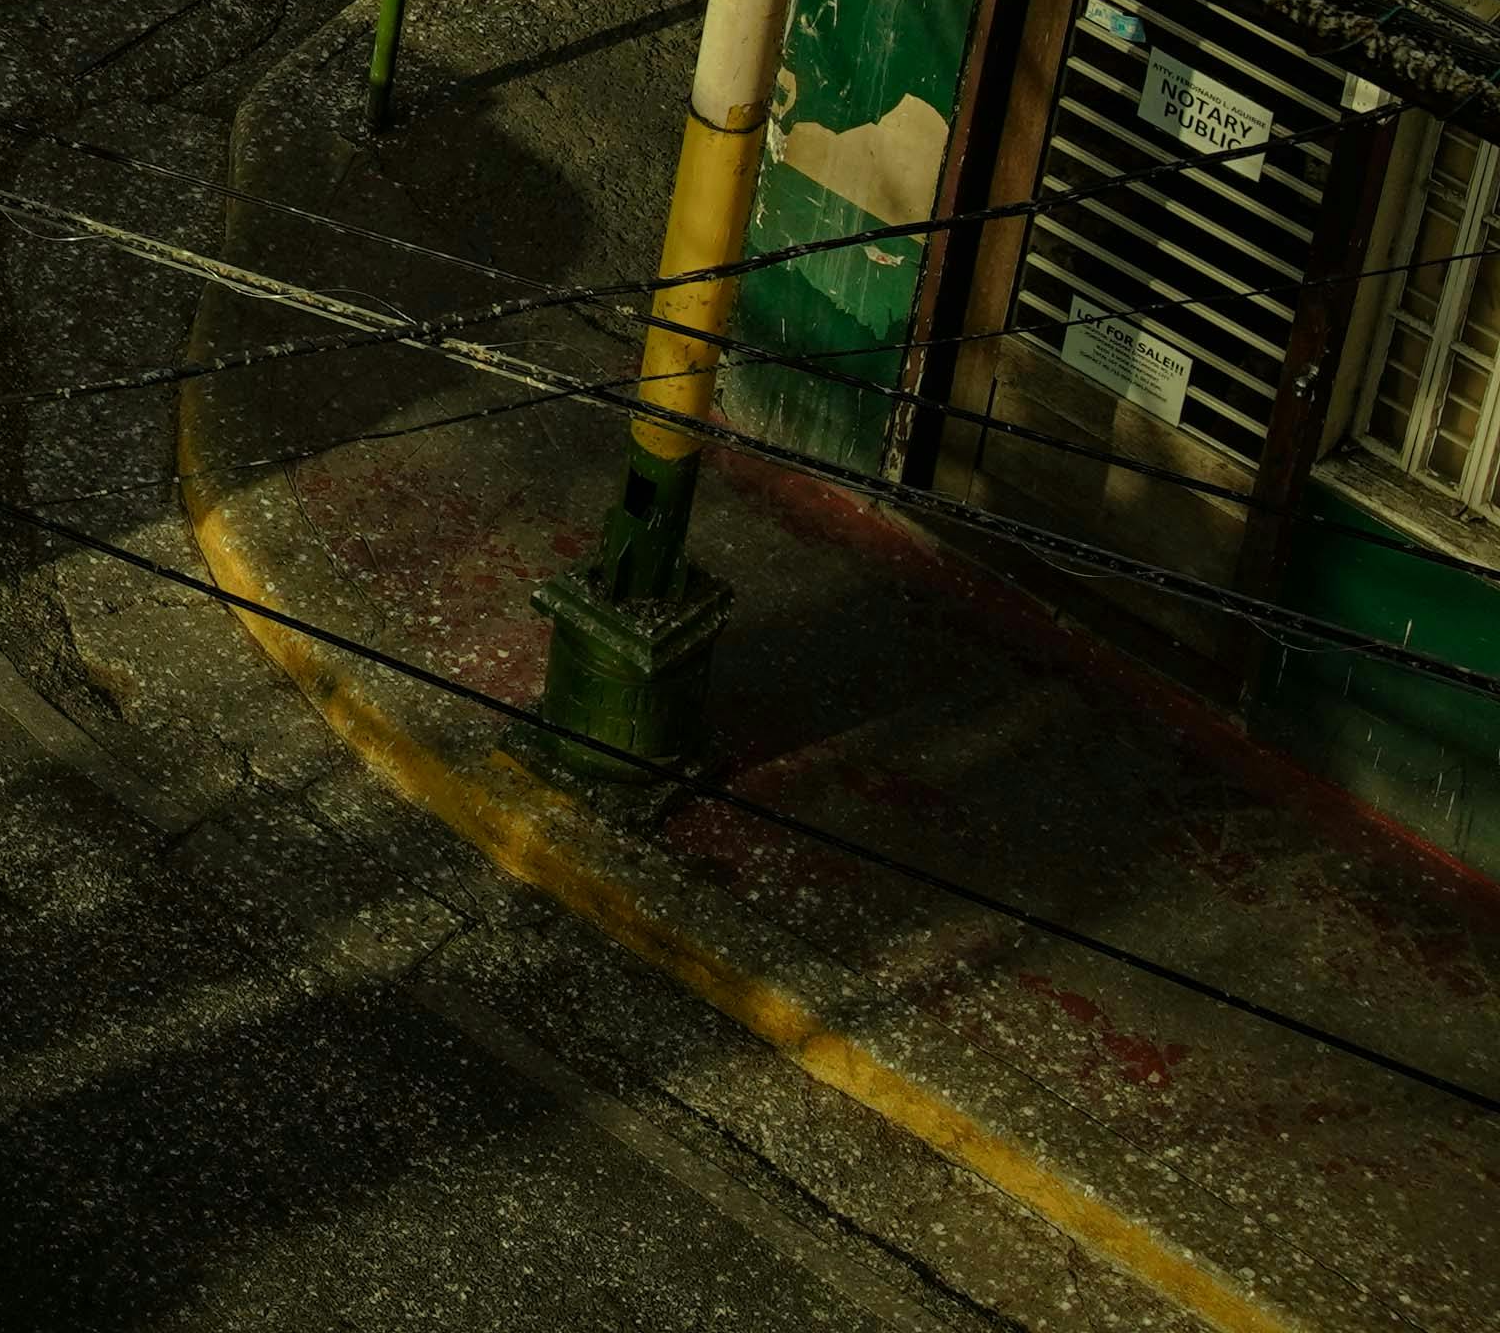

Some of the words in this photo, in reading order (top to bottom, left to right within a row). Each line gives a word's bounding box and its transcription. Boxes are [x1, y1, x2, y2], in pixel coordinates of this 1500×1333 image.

[1153, 63, 1175, 80] ATTY.
[1176, 74, 1221, 105] FERDINAND
[1232, 107, 1267, 129] AGUIRRE
[1162, 79, 1252, 139] NOTARY
[1164, 102, 1242, 150] PUBLIC
[1078, 309, 1103, 329] LOT
[1106, 325, 1134, 347] FOR
[1137, 342, 1185, 376] SALE!!!
